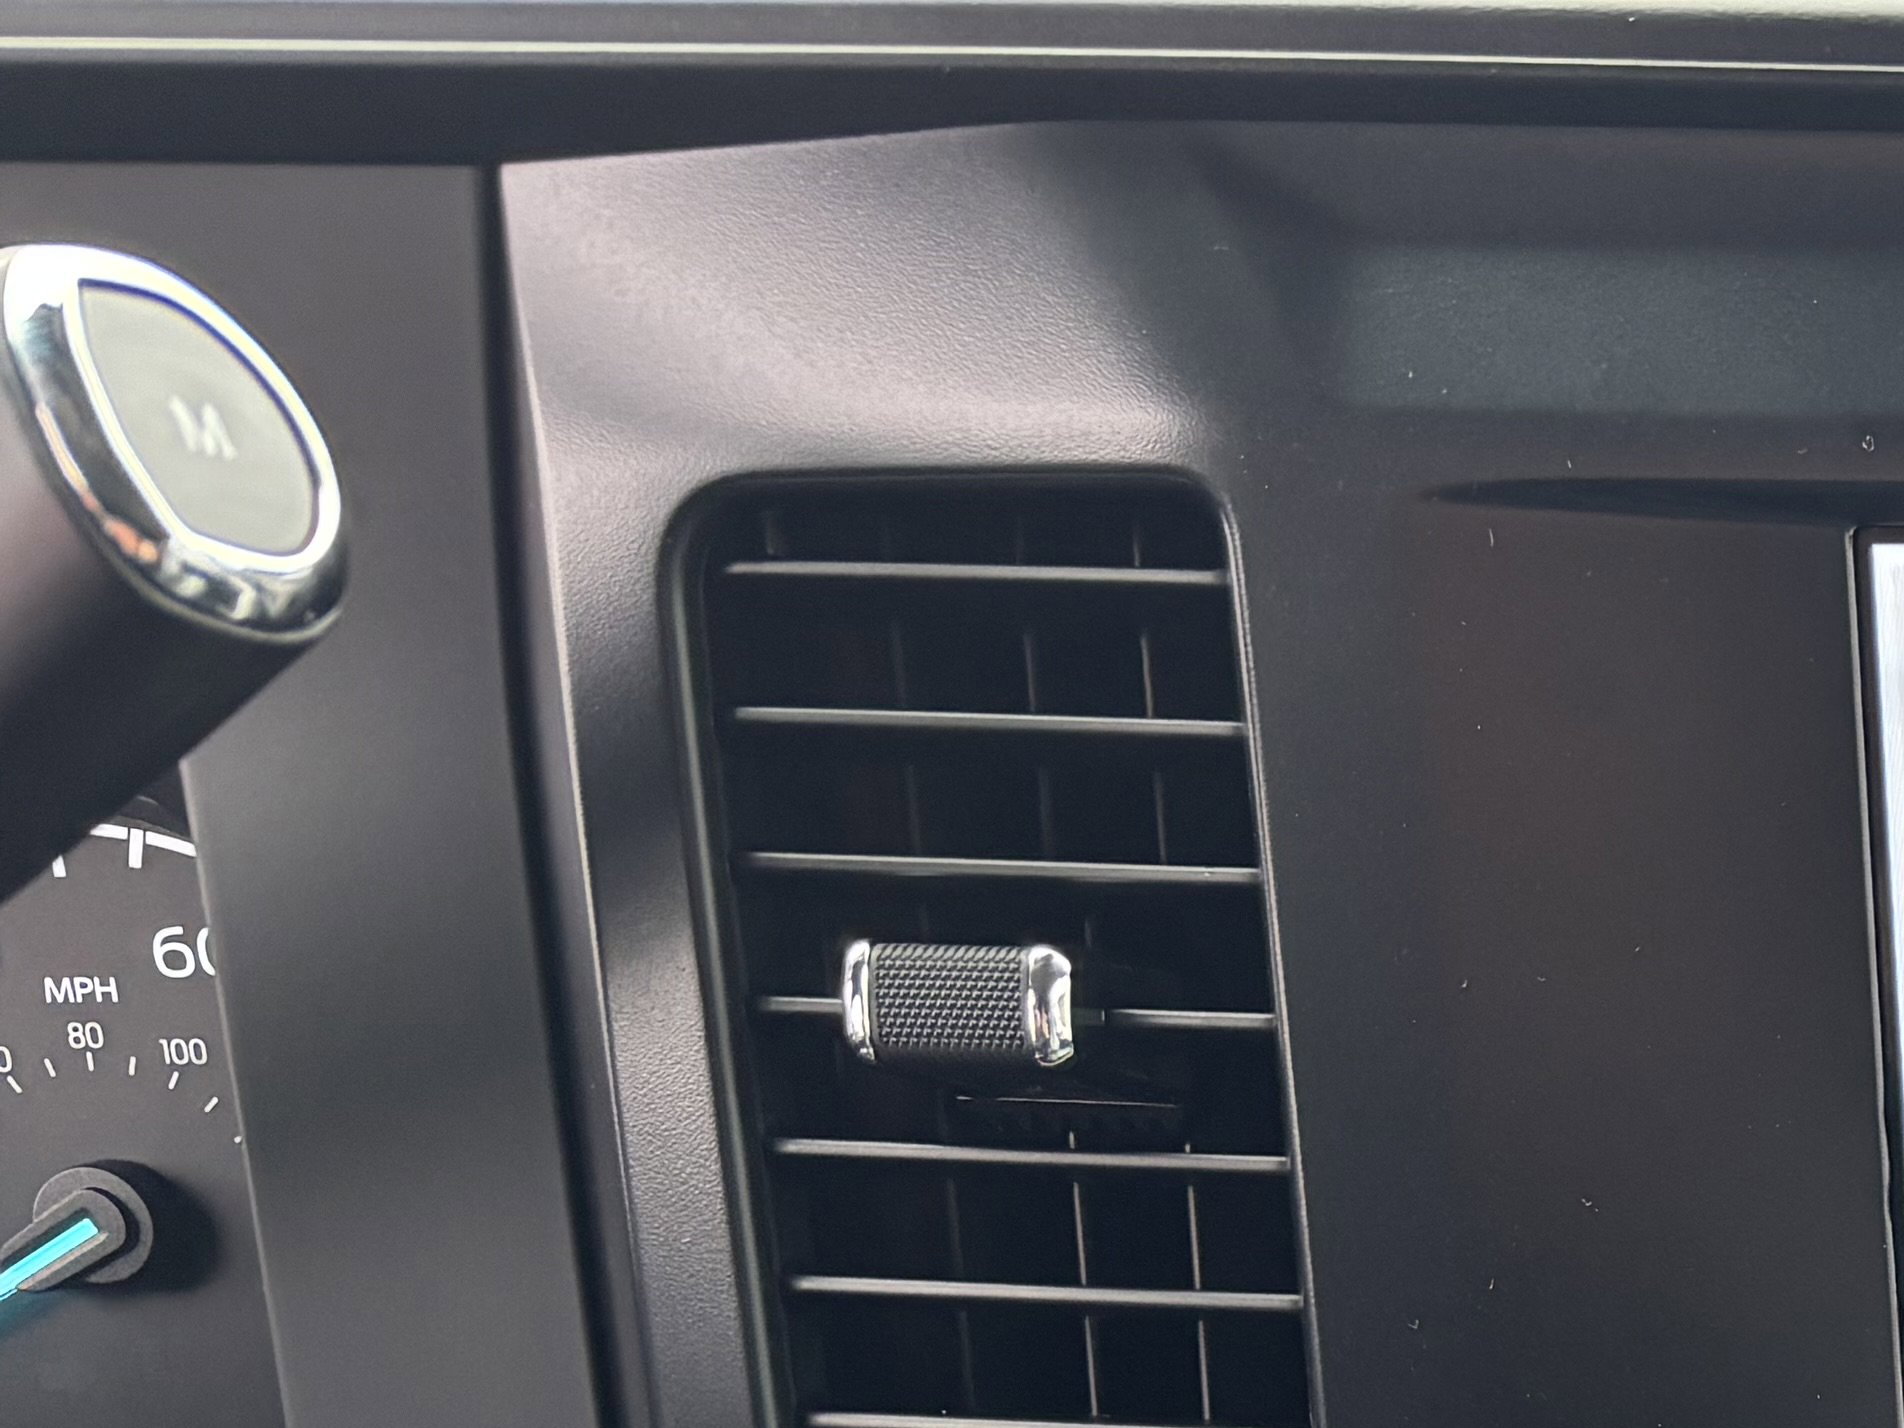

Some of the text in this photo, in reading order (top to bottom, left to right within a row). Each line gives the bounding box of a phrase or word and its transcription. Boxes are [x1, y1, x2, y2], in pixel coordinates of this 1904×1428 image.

[44, 976, 119, 1003] MPH
[67, 1021, 104, 1049] 80
[159, 1038, 208, 1065] 100
